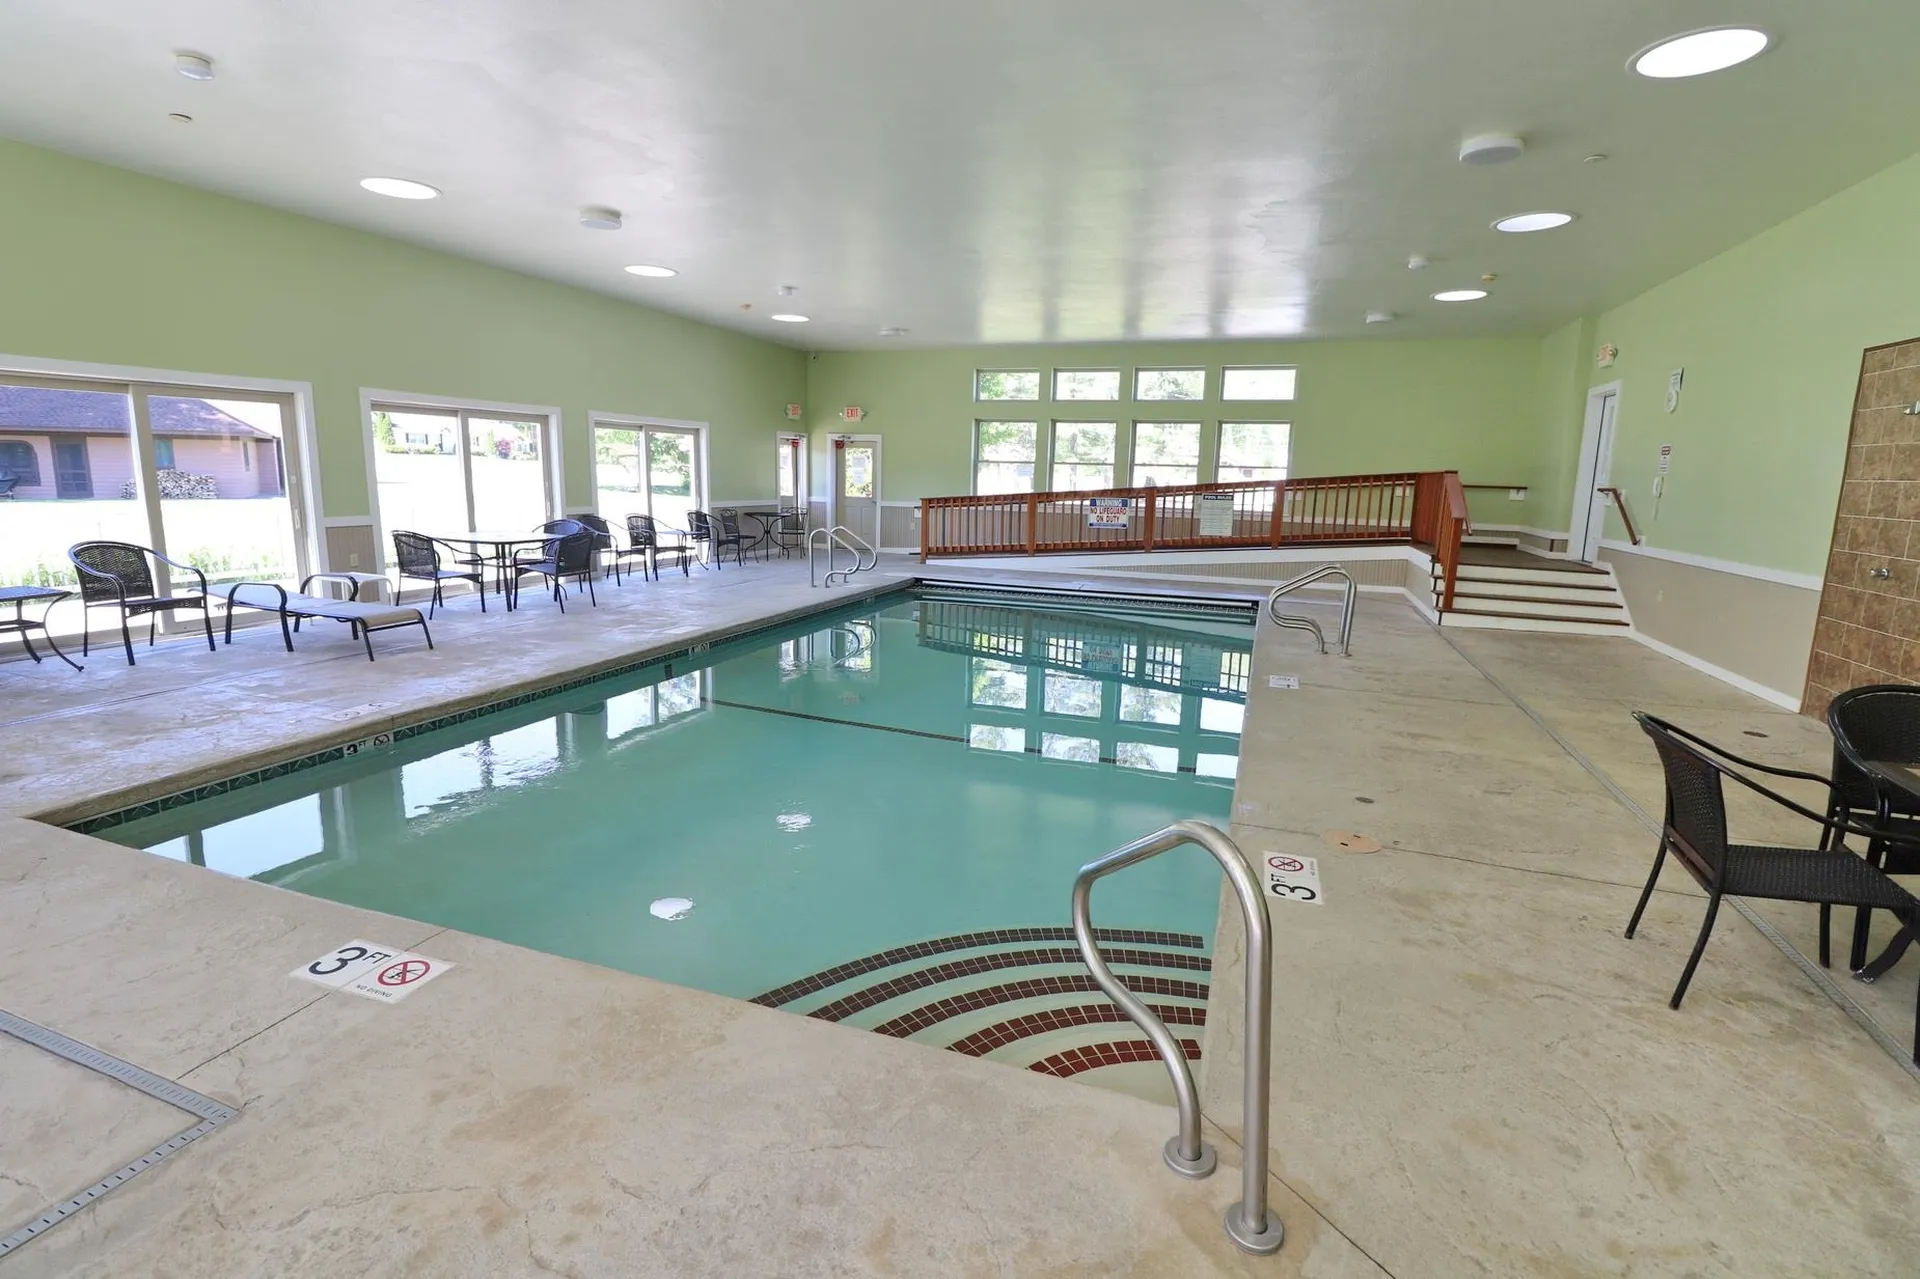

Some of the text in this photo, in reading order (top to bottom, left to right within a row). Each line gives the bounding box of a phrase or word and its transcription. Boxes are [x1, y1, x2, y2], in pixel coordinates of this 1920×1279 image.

[846, 408, 859, 418] EXIT
[1096, 499, 1122, 507] WARNING
[1100, 507, 1127, 515] LIFEGUARD
[1106, 515, 1120, 523] DUTY
[346, 744, 358, 755] 3
[1271, 873, 1316, 900] 3 FT
[308, 947, 391, 975] 3 FT
[355, 984, 393, 998] NO DIVING
